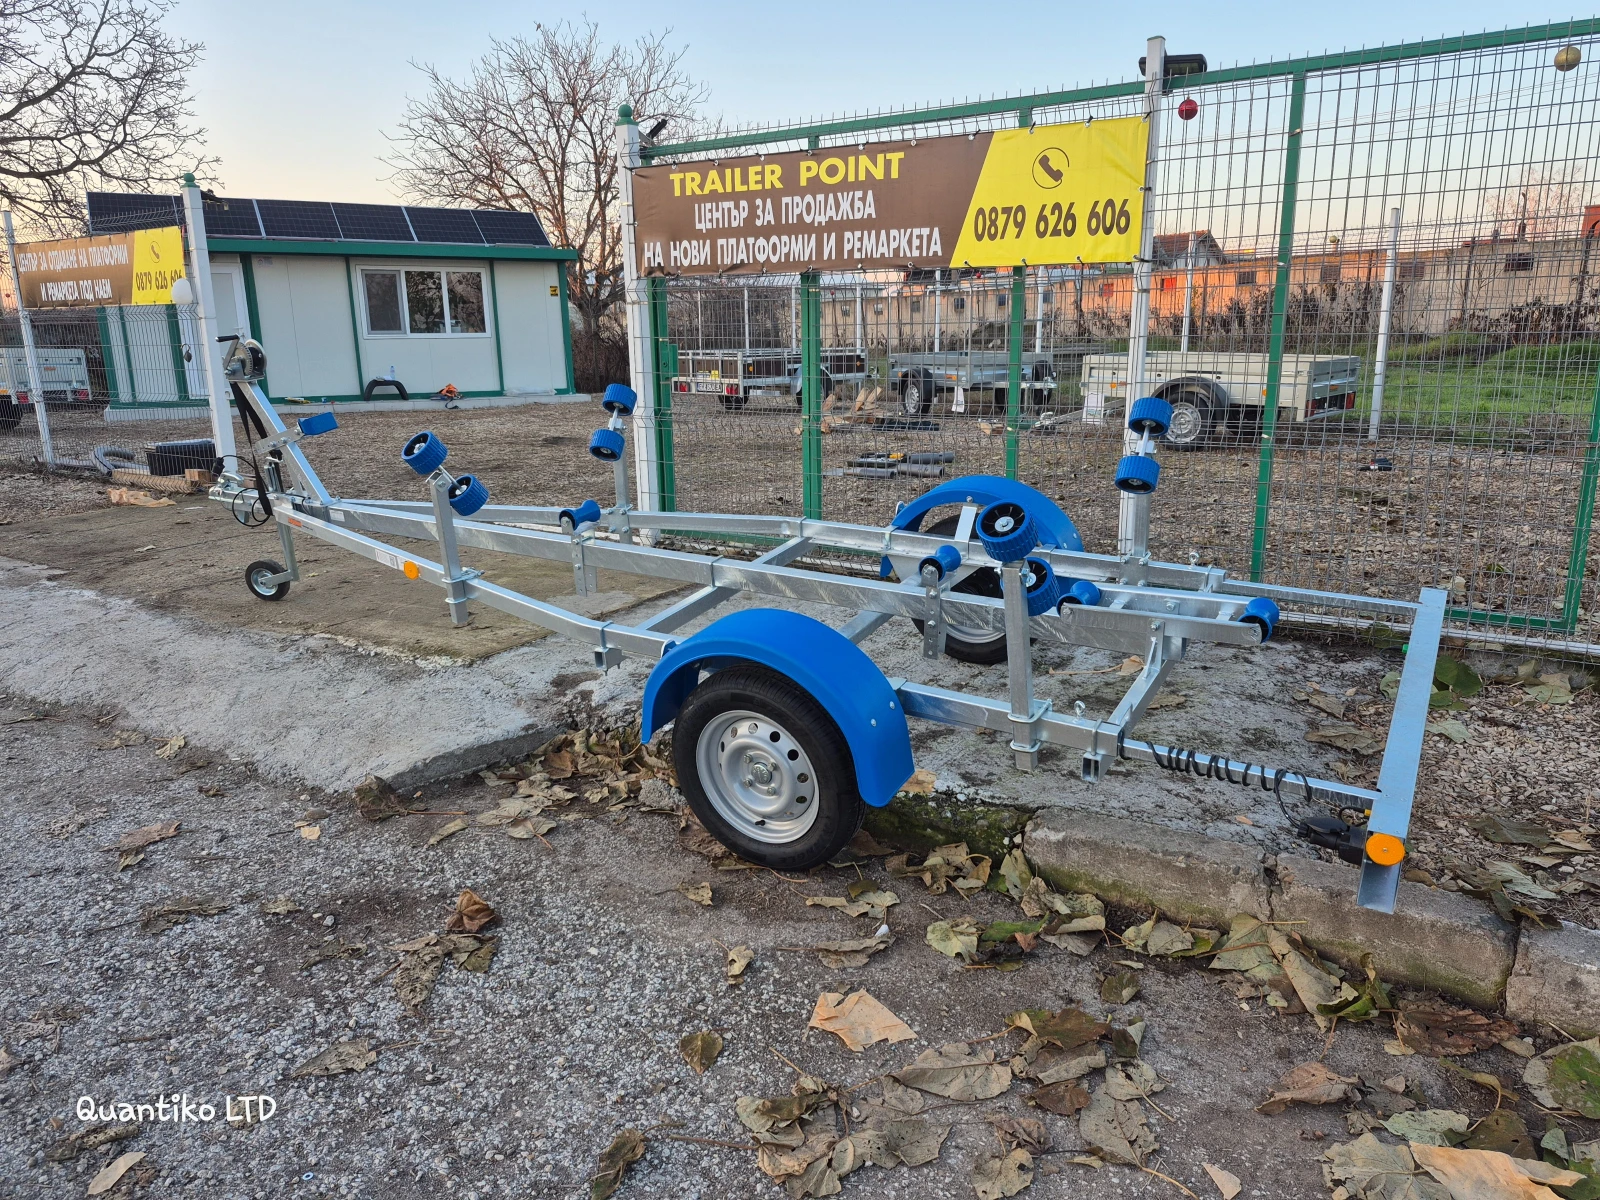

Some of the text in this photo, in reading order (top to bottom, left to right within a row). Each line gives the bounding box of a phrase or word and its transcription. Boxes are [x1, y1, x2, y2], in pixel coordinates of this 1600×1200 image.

[669, 151, 905, 197] TRAILER POINT
[694, 189, 876, 233] ЦЕНТЪР ЗА ПРОДАЖБА
[973, 198, 1131, 242] 0879 626 606
[16, 243, 129, 274] ЦЕНТЪР ЗА ОТДАВАНЕ НА ПЛАТФОРМИ
[644, 227, 943, 268] НА НОВИ ПЛАТФОРМИ И РЕМАРКЕТА
[40, 278, 113, 302] И РЕМАРКЕТА ПОД НАЕМ
[135, 271, 153, 292] 0879
[155, 270, 168, 290] 626
